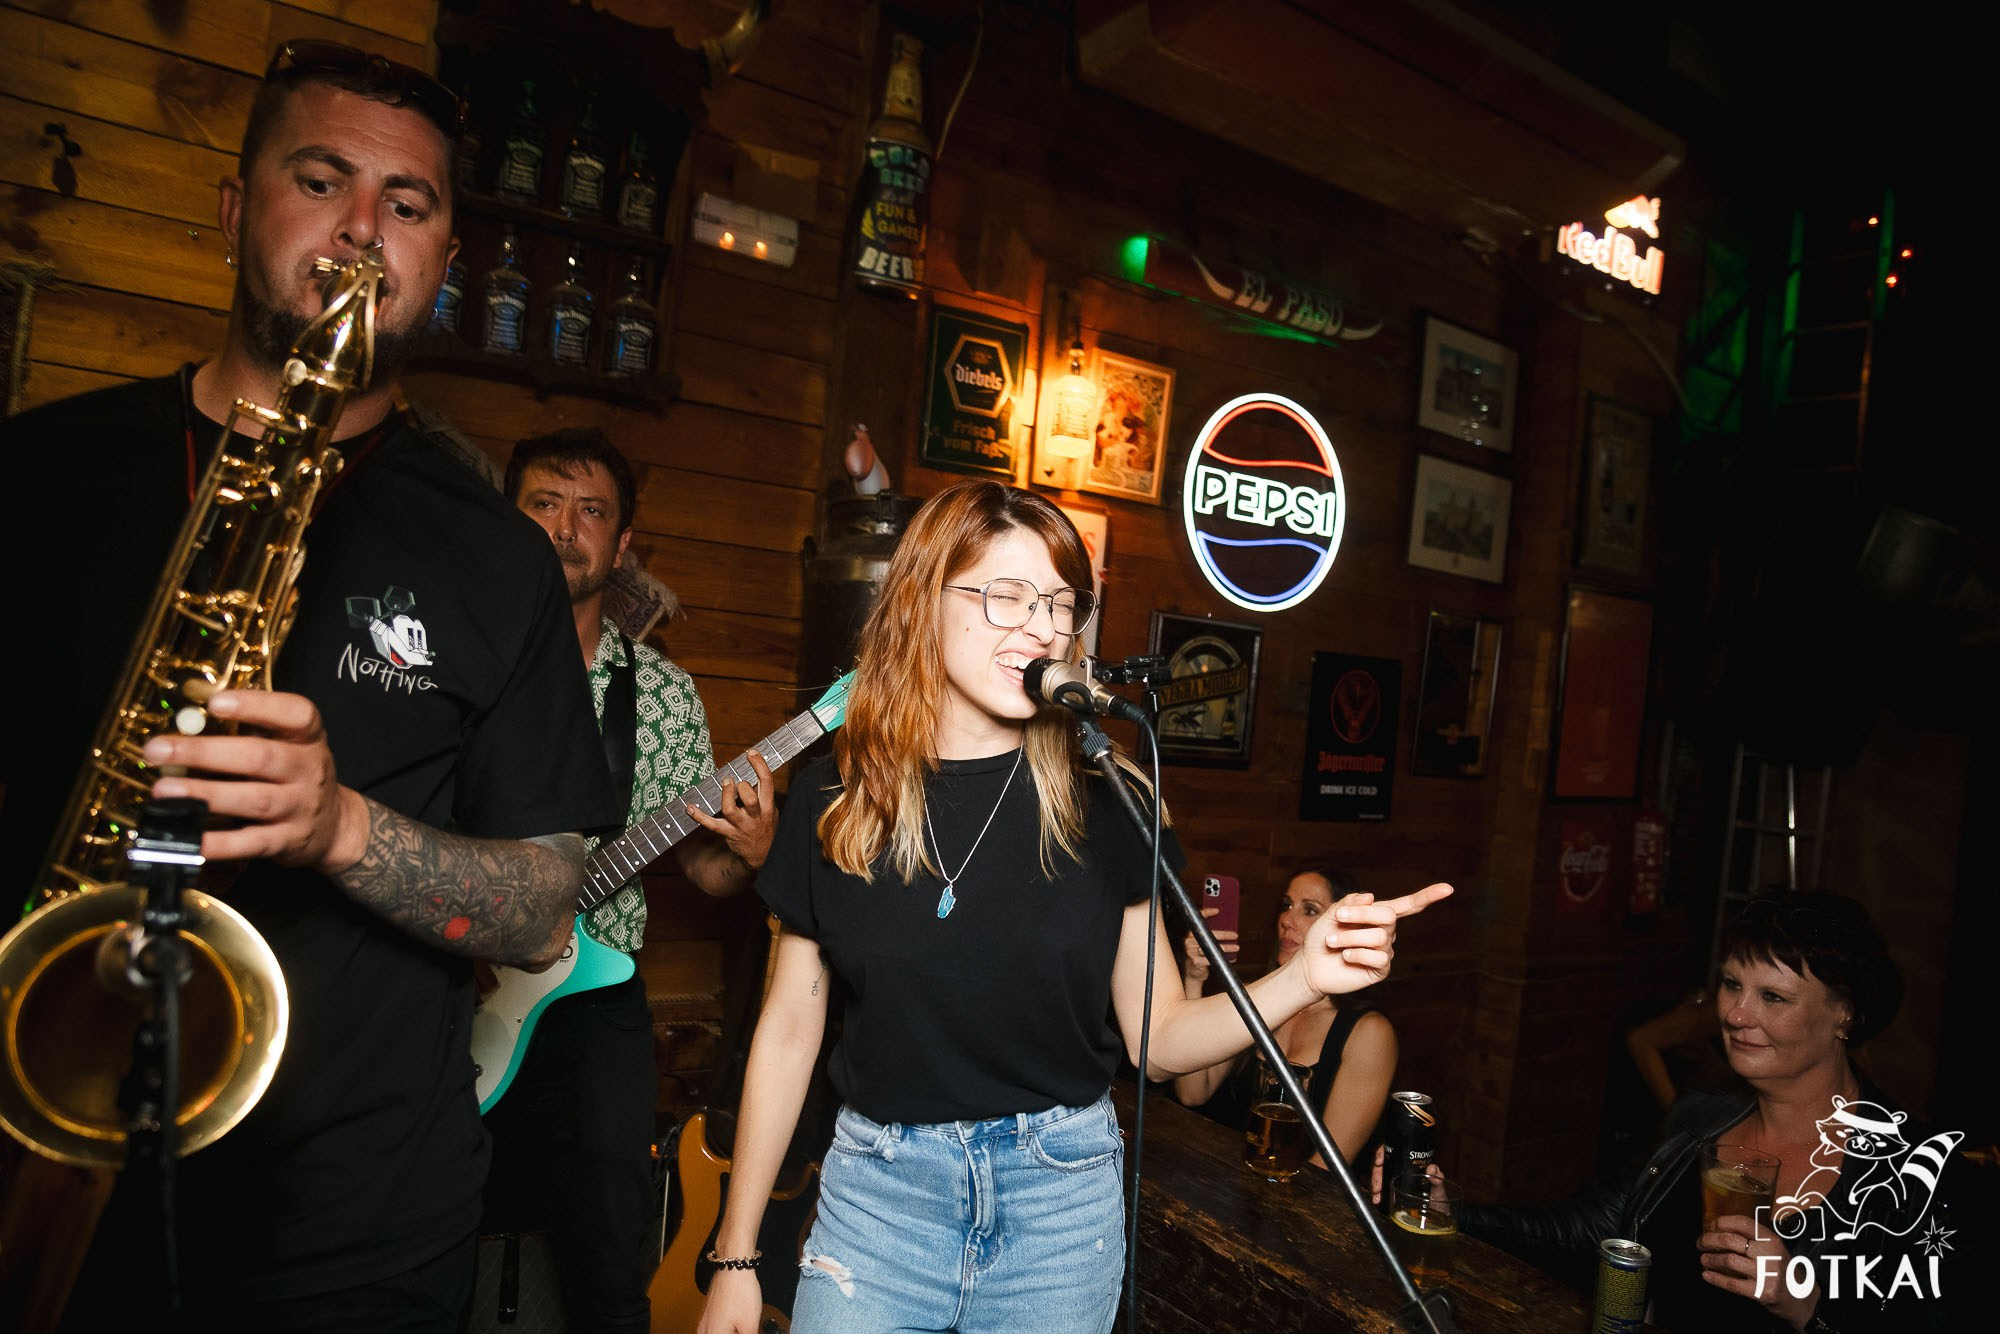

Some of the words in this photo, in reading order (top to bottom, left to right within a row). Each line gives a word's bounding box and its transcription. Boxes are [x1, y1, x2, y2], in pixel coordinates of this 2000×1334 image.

[875, 201, 905, 219] FUN
[1234, 269, 1274, 314] EL
[1276, 285, 1344, 337] PASO
[955, 363, 1004, 391] Diebels
[953, 419, 996, 441] Frisch
[1194, 464, 1337, 538] PEPSI
[1320, 784, 1343, 795] DRINK
[1344, 785, 1356, 795] ICE
[1358, 785, 1378, 796] COLD
